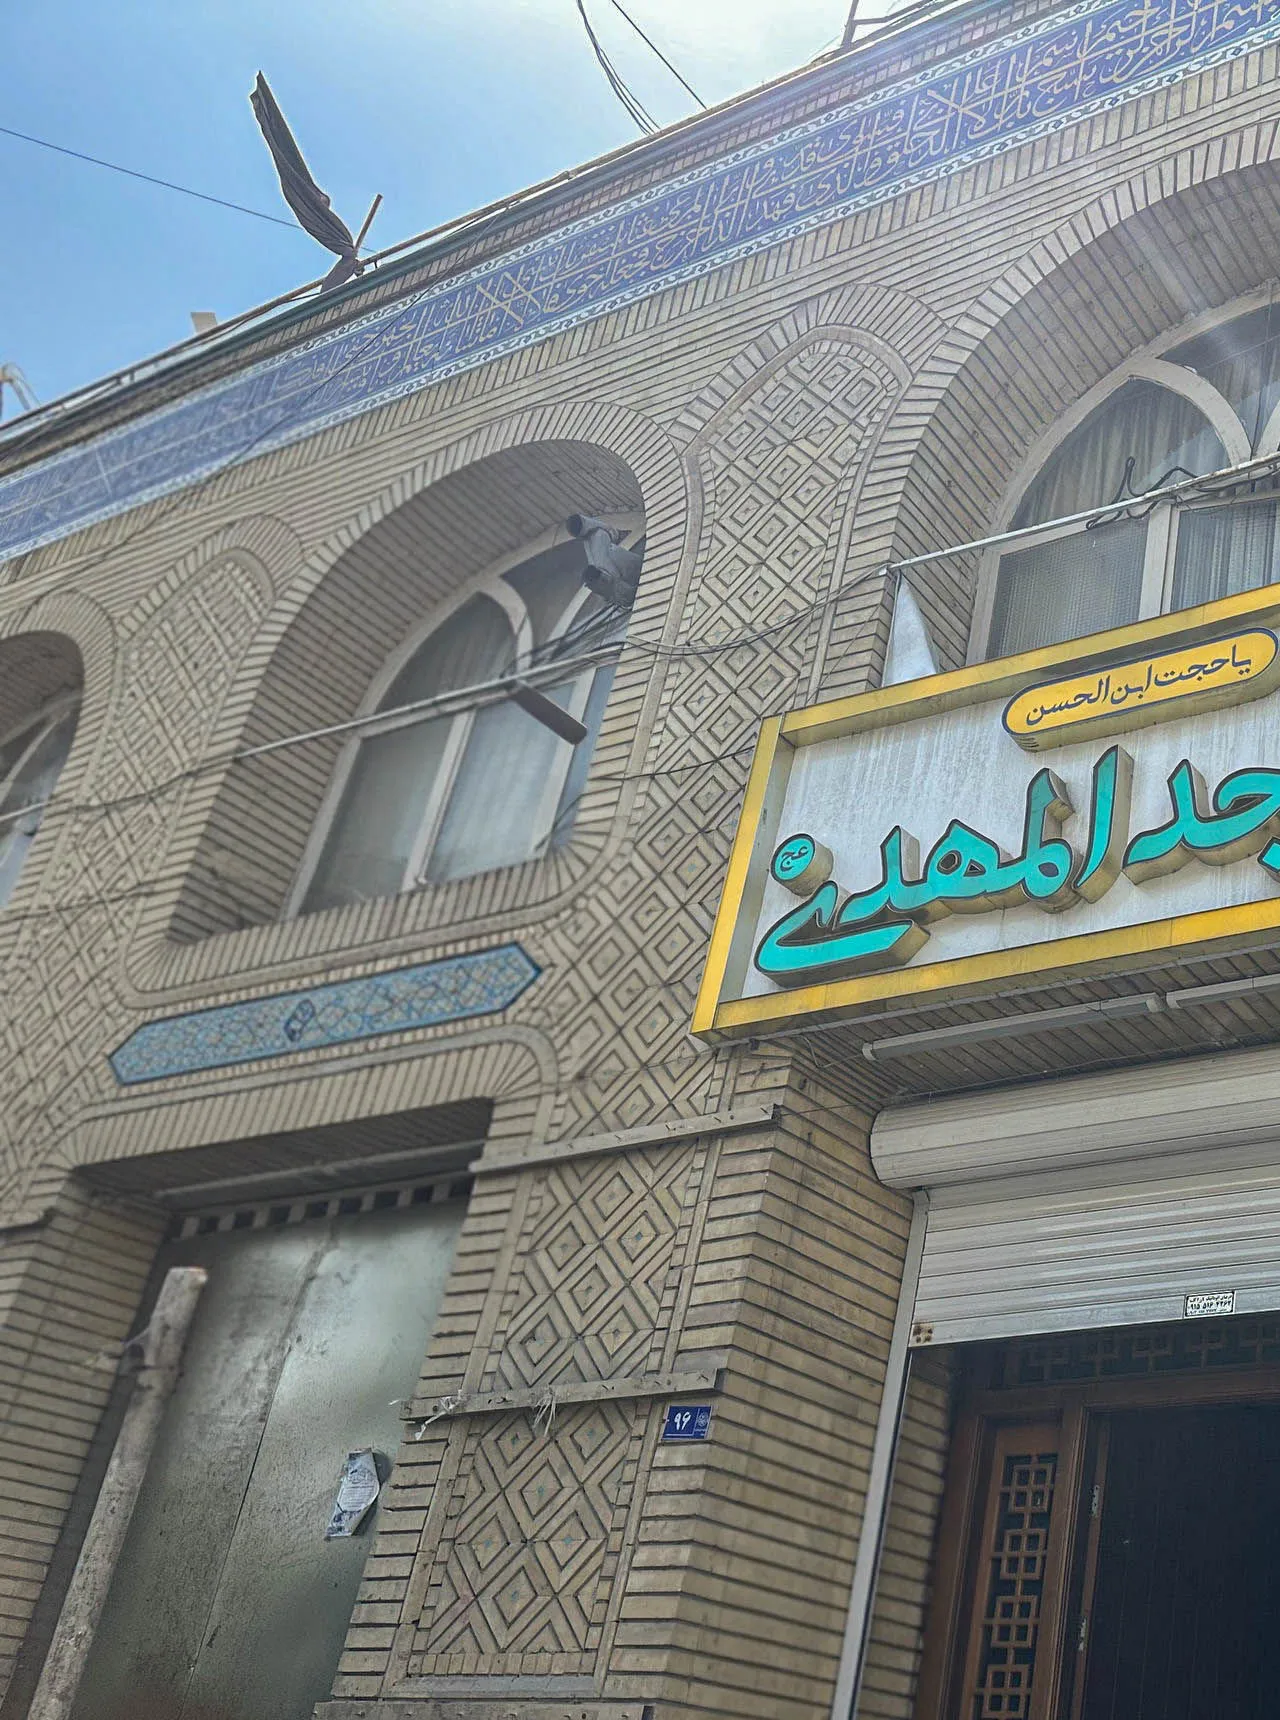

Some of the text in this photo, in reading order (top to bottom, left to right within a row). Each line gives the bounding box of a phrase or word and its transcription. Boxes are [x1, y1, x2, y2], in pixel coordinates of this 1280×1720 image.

[1110, 663, 1153, 705] ابن
[1153, 655, 1230, 687] حجت
[1025, 674, 1111, 727] الحسن
[674, 1411, 692, 1430] ۹۶
